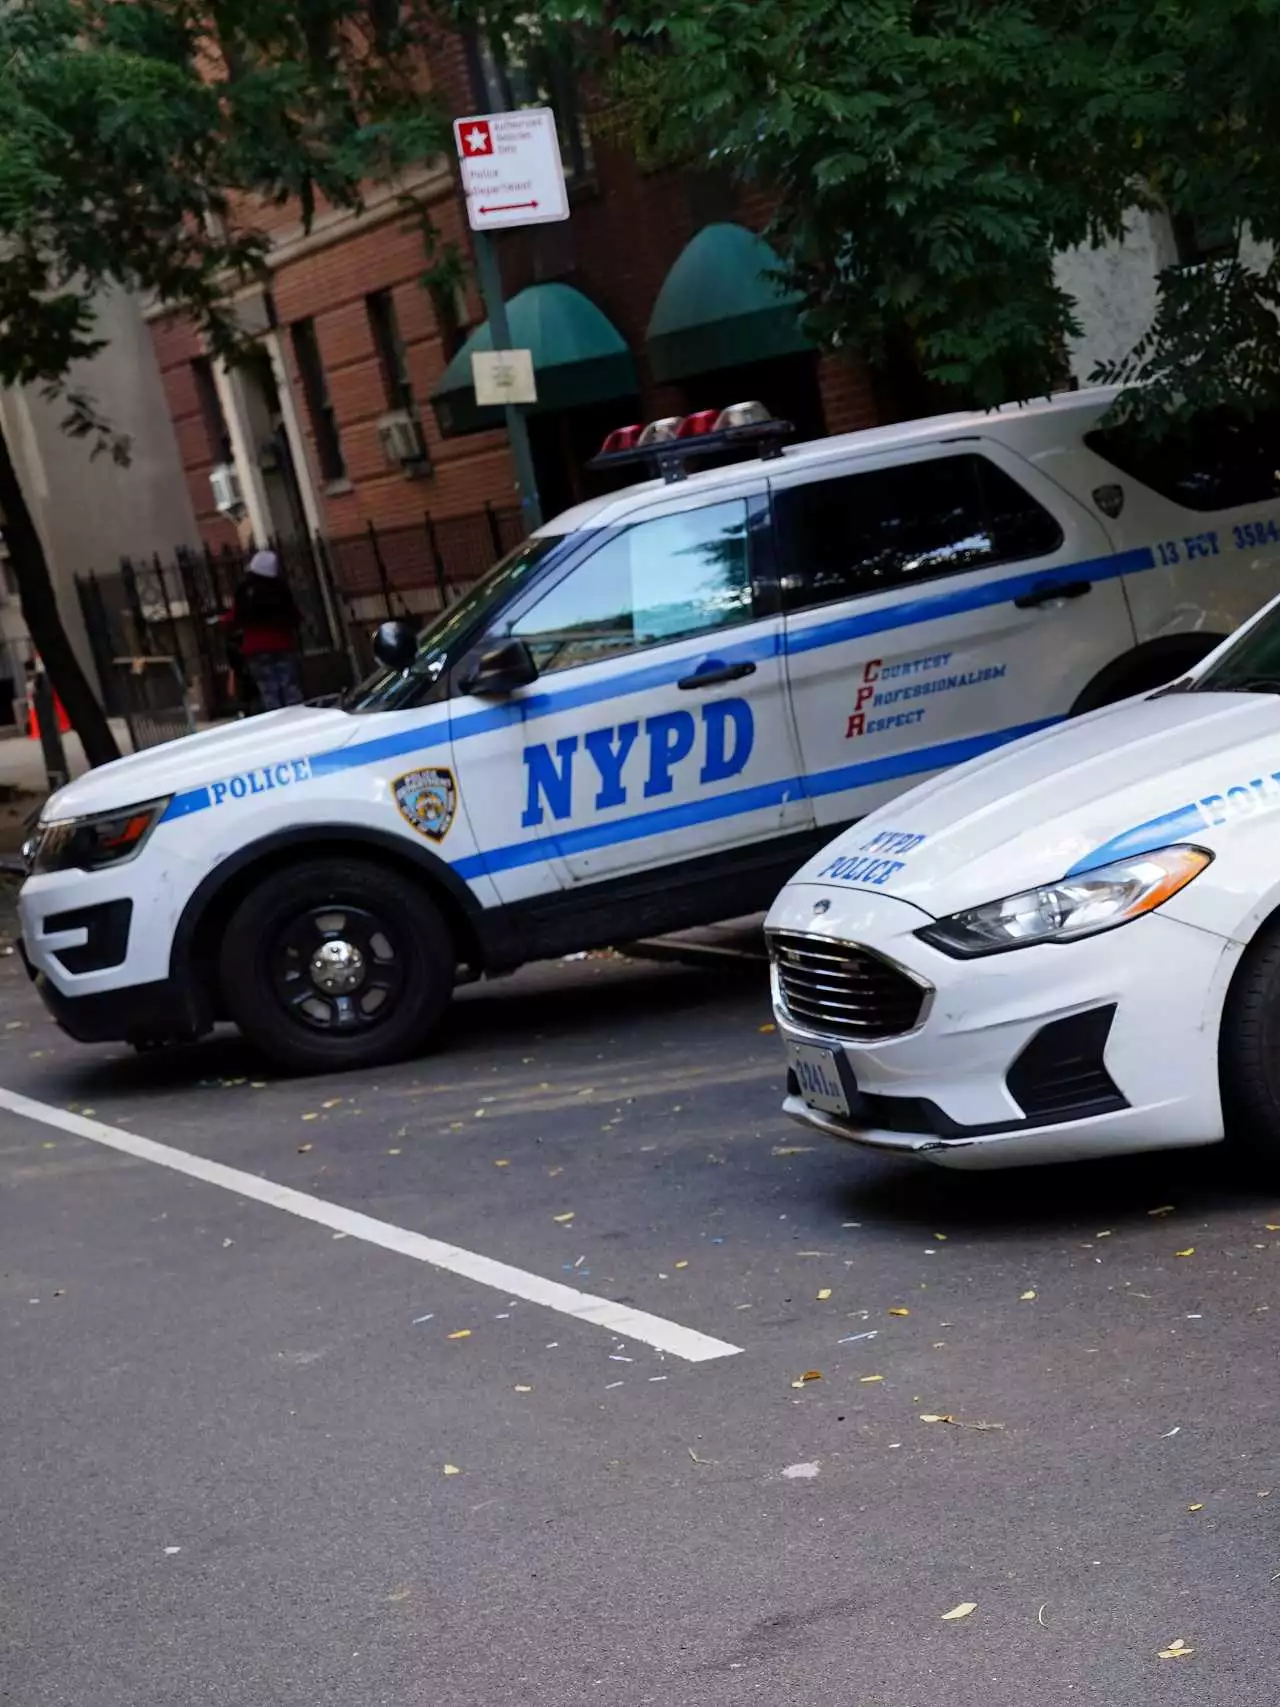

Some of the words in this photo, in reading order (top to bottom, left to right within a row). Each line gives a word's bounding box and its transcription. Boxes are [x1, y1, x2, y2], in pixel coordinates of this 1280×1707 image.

[1157, 541, 1181, 566] 13
[1182, 531, 1221, 561] PCT
[863, 652, 953, 684] COURTESY
[854, 664, 1007, 712] PROFESSIONALISM
[845, 708, 925, 739] RESPECT
[520, 697, 755, 829] NYPD
[211, 759, 310, 805] POLICE
[858, 831, 927, 854] NYPD
[817, 856, 907, 885] POLICE
